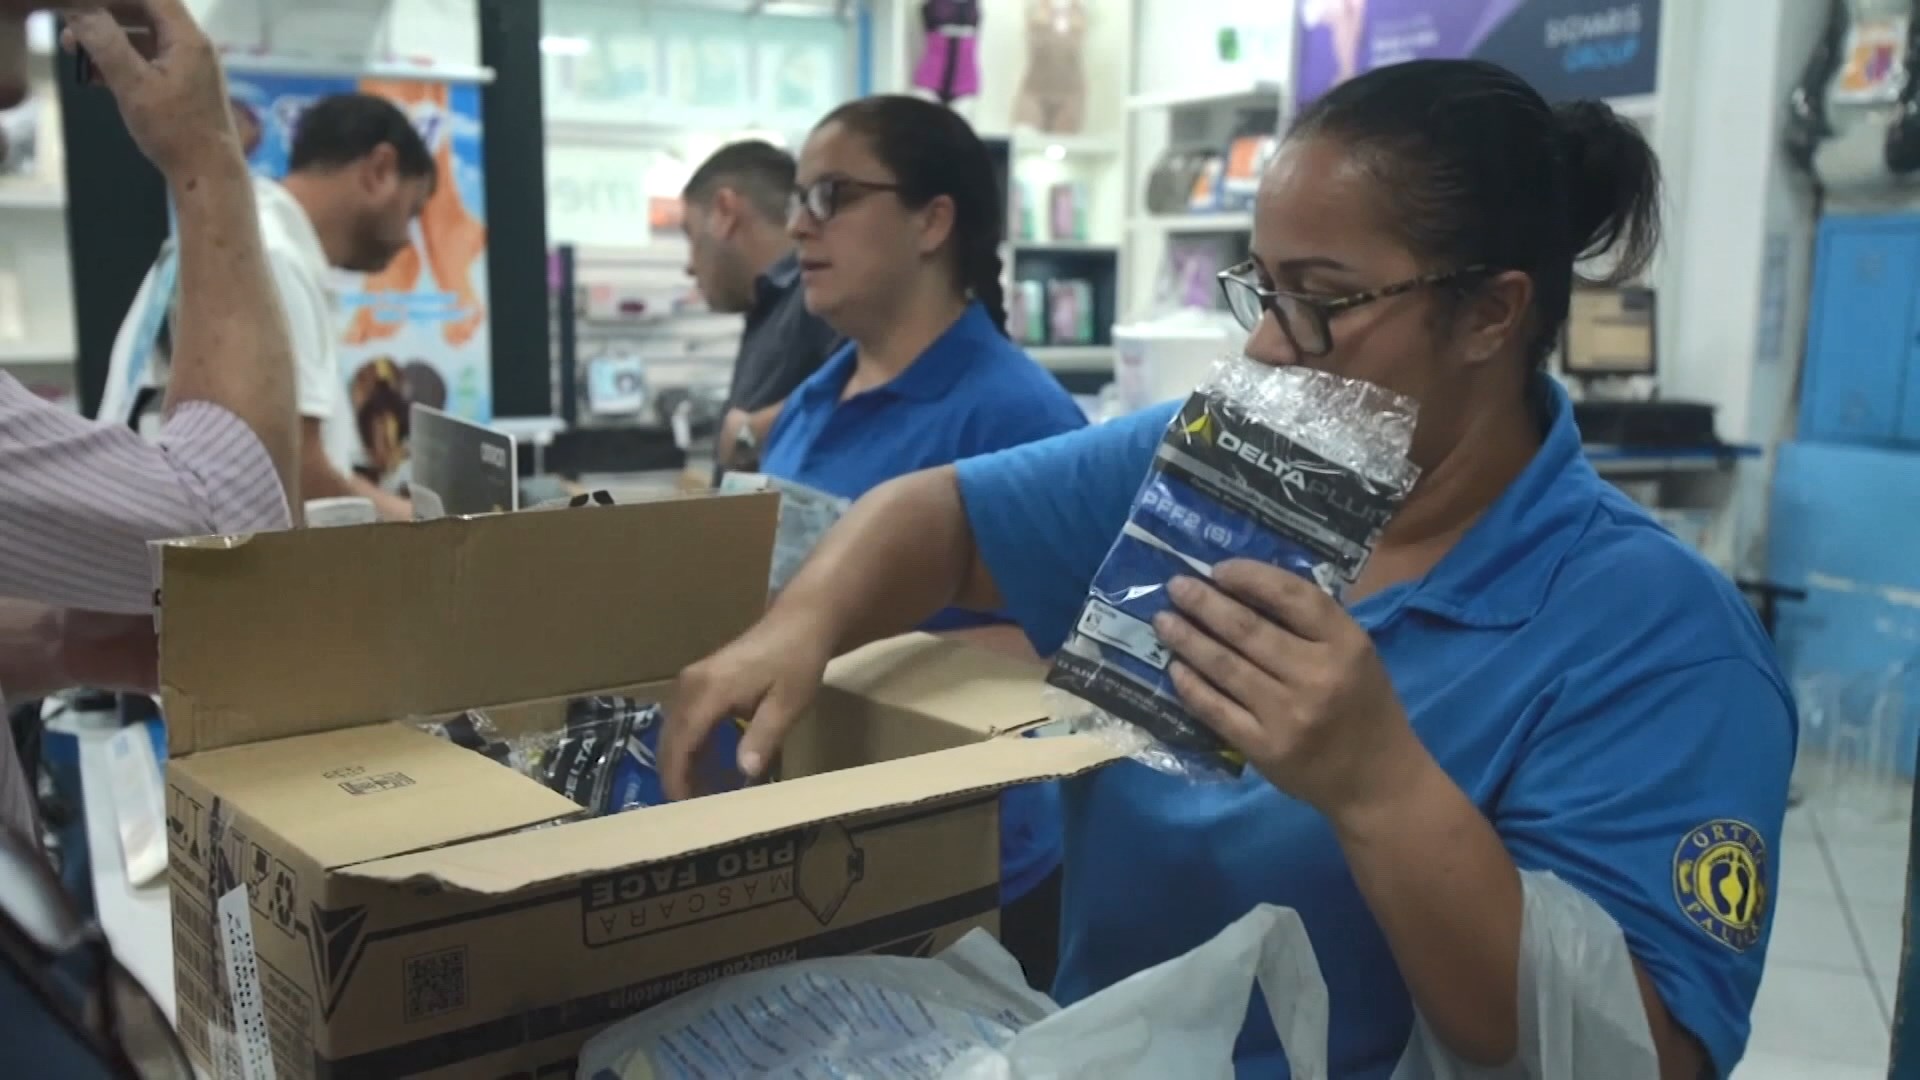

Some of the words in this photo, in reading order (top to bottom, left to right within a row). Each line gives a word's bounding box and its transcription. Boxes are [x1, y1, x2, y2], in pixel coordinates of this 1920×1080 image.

[1142, 489, 1203, 529] PFF2
[718, 842, 795, 877] PRO
[592, 863, 697, 904] FACE
